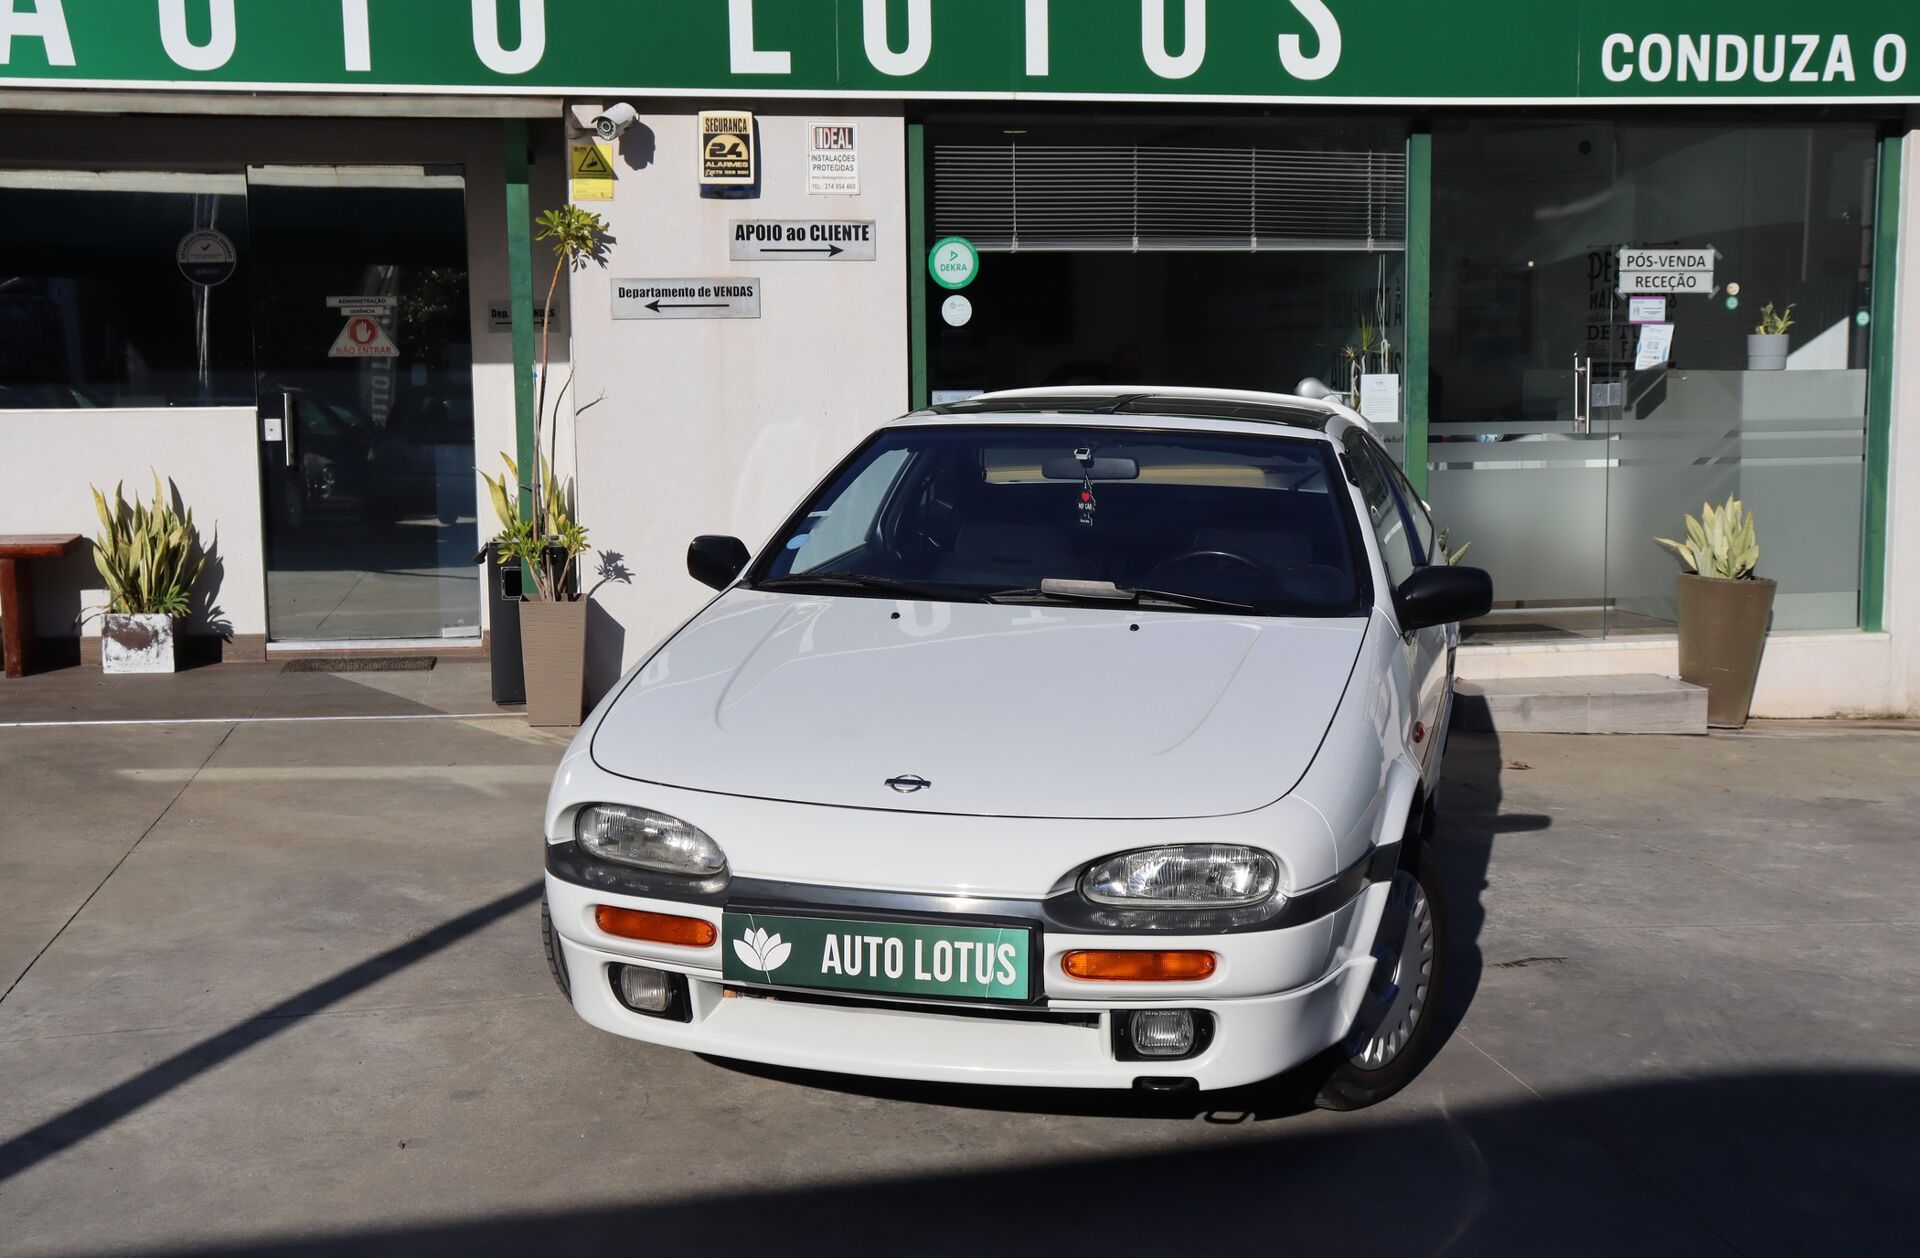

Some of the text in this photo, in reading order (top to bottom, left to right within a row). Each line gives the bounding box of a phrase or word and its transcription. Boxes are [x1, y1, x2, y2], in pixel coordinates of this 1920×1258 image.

[1601, 33, 1907, 82] CONDUZA O
[709, 142, 742, 157] 24
[811, 153, 855, 163] INSTALAÇÕES
[813, 164, 854, 172] PROTEGIDAS
[735, 224, 869, 241] APOIO ao CLIENTE
[1627, 252, 1706, 267] PÓS-VENDA
[940, 263, 968, 272] DEKRA
[1635, 273, 1697, 291] RECEÇÃO
[618, 286, 753, 300] Departamento de VENDAS
[336, 345, 392, 354] NÃO ENTRAR
[821, 933, 1016, 986] AUTO LOTUS
